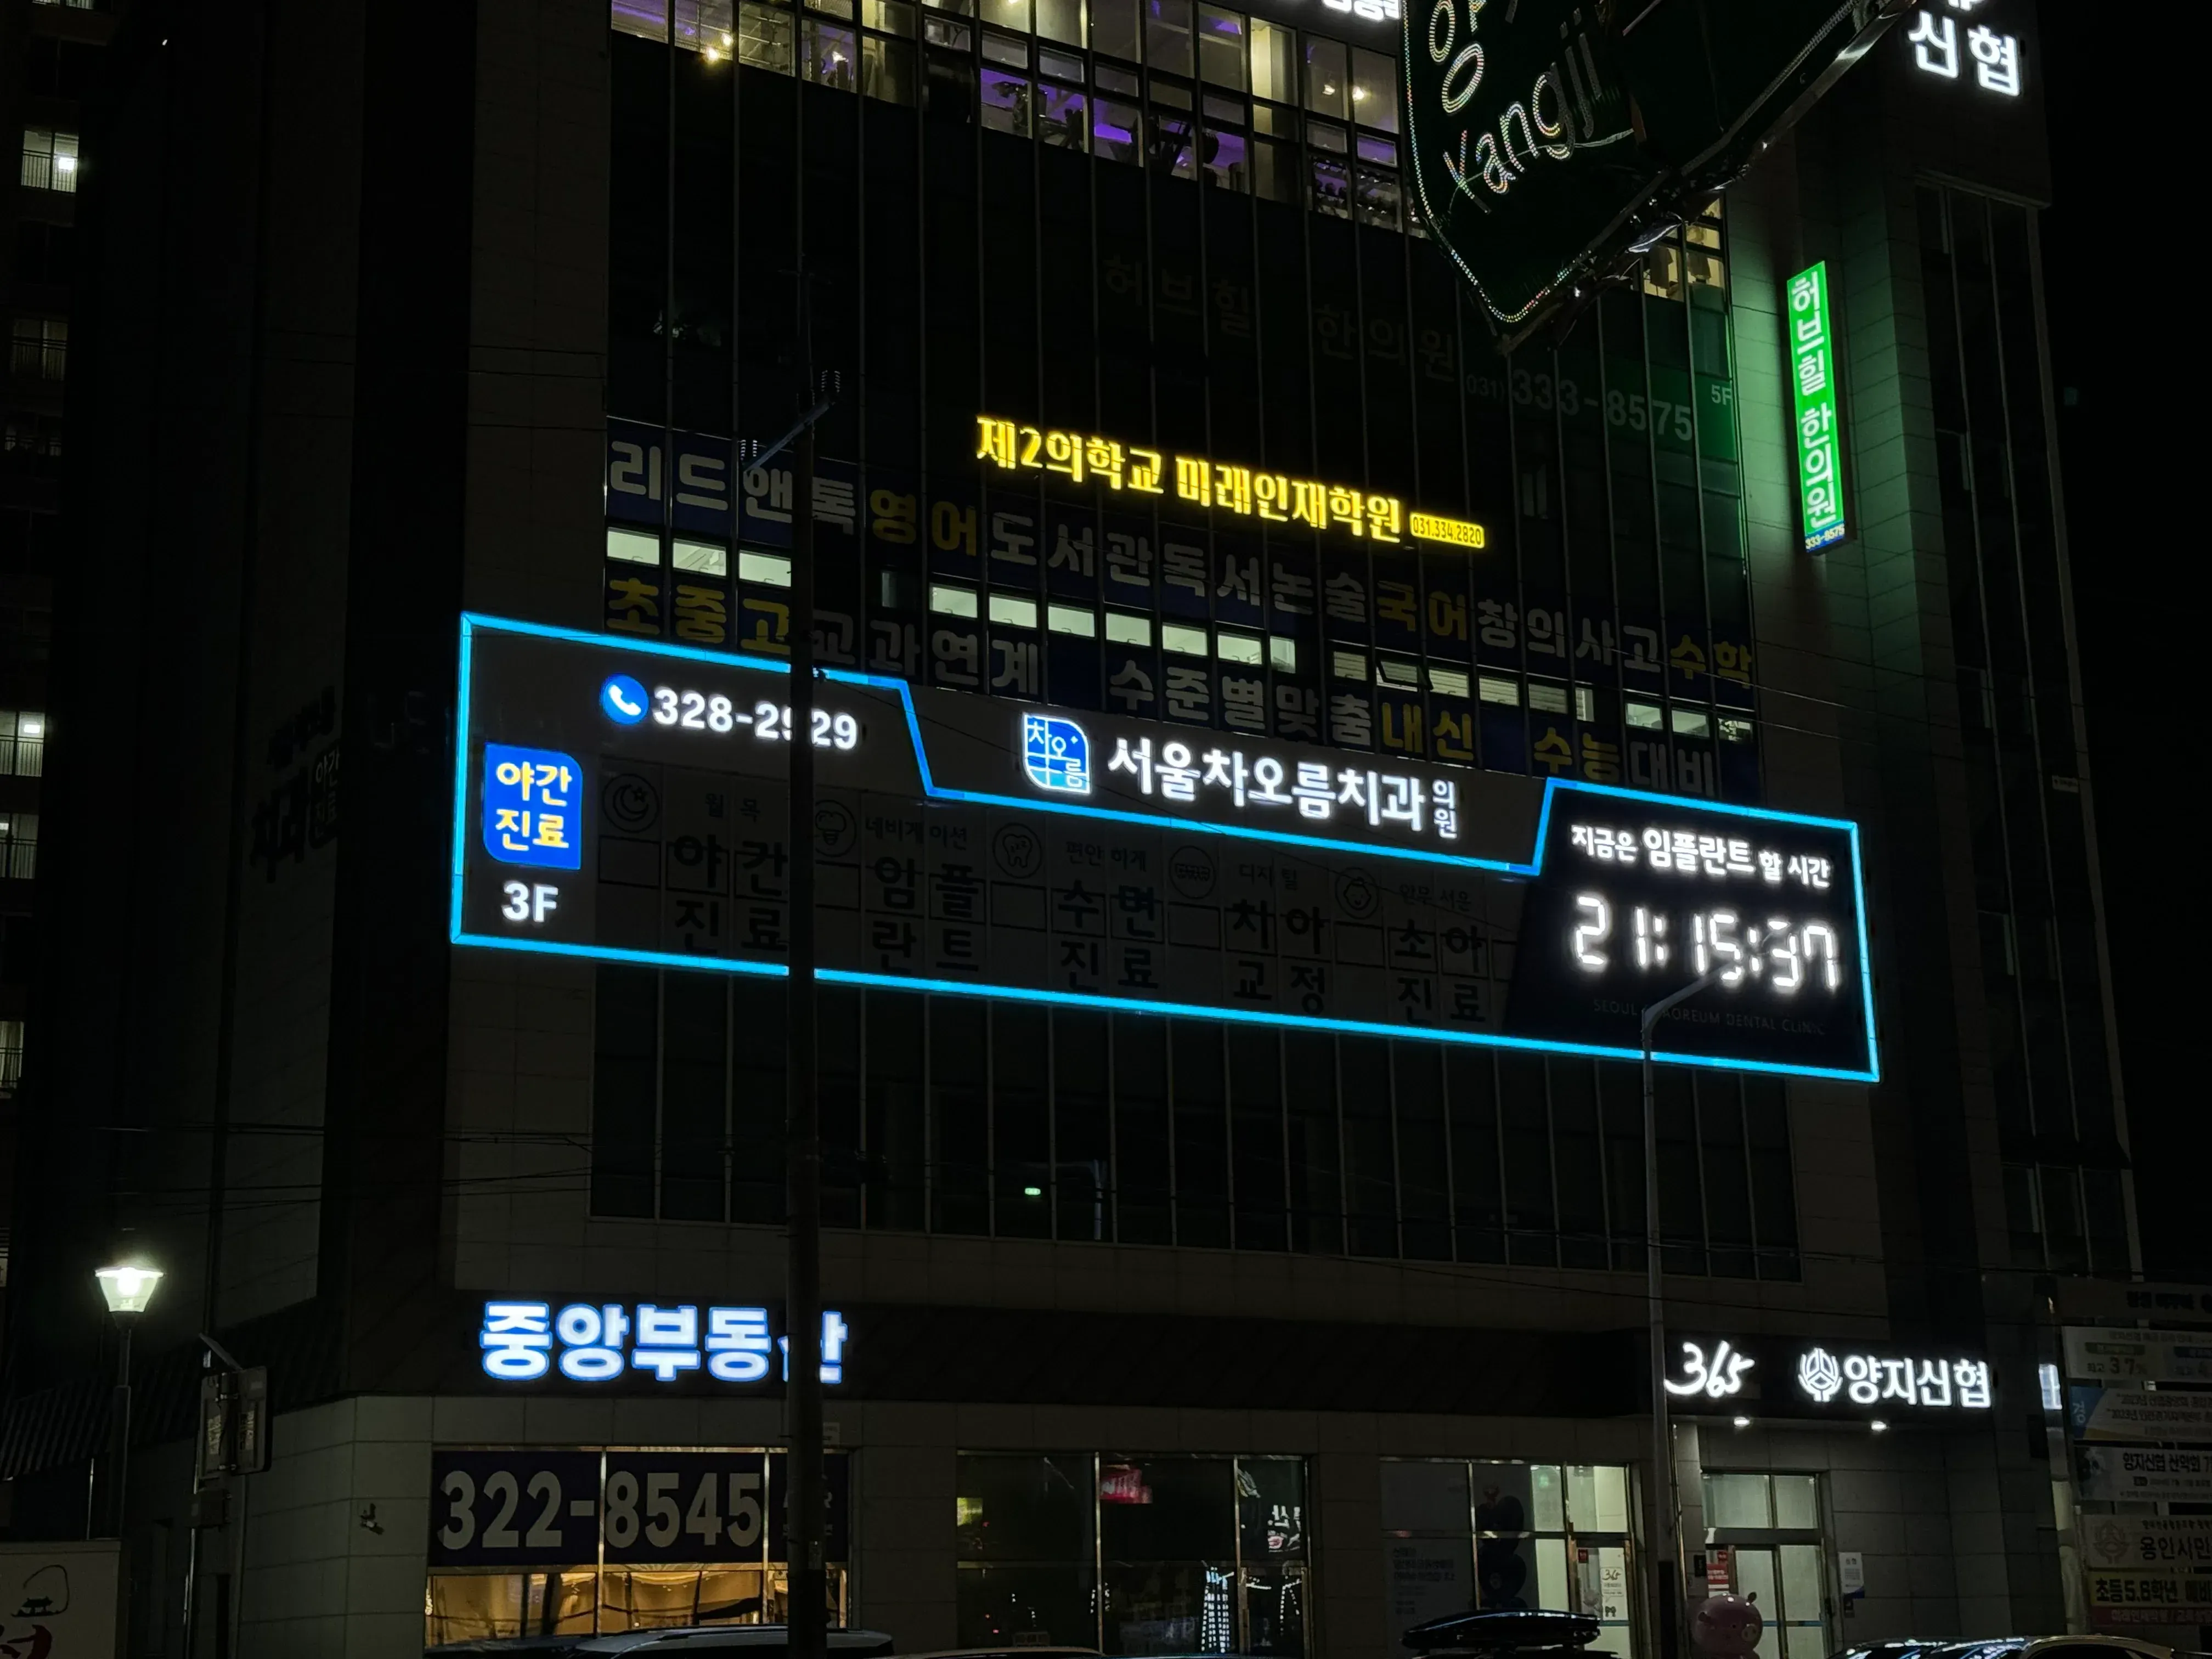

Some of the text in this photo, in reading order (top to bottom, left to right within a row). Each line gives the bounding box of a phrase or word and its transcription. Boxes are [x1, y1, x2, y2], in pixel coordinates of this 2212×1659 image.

[1908, 9, 2021, 97] 신협
[1442, 7, 1602, 215] Yangji
[1103, 254, 1252, 338] 허브힐
[1316, 304, 1455, 382] 한의원
[1511, 368, 1694, 441] 333-8575
[1711, 383, 1733, 407] 5F
[1791, 271, 1837, 529] 허브힐 한의원
[975, 414, 1482, 546] 제2의학교 미래인재학원 031.334.2820
[495, 760, 573, 806] 야간
[1107, 735, 1426, 834] 서울차오름치과
[1431, 778, 1459, 840] 의원
[495, 809, 569, 851] 진료
[1571, 823, 1832, 889] 지금은 임플란트 할 시간
[501, 881, 560, 923] 3F
[674, 900, 788, 954] 진료
[1060, 940, 1159, 990] 진료
[1575, 893, 1842, 995] 21:15:37
[1234, 960, 1327, 1017] 교정
[1396, 977, 1486, 1026] 진료
[1593, 999, 1638, 1017] SEOUL
[1640, 1004, 1720, 1024] AOREUM
[1726, 1013, 1776, 1031] DENTAL
[1662, 1340, 1756, 1398] 365
[1843, 1353, 1993, 1409] 양지신협
[436, 1470, 762, 1550] 322-8545
